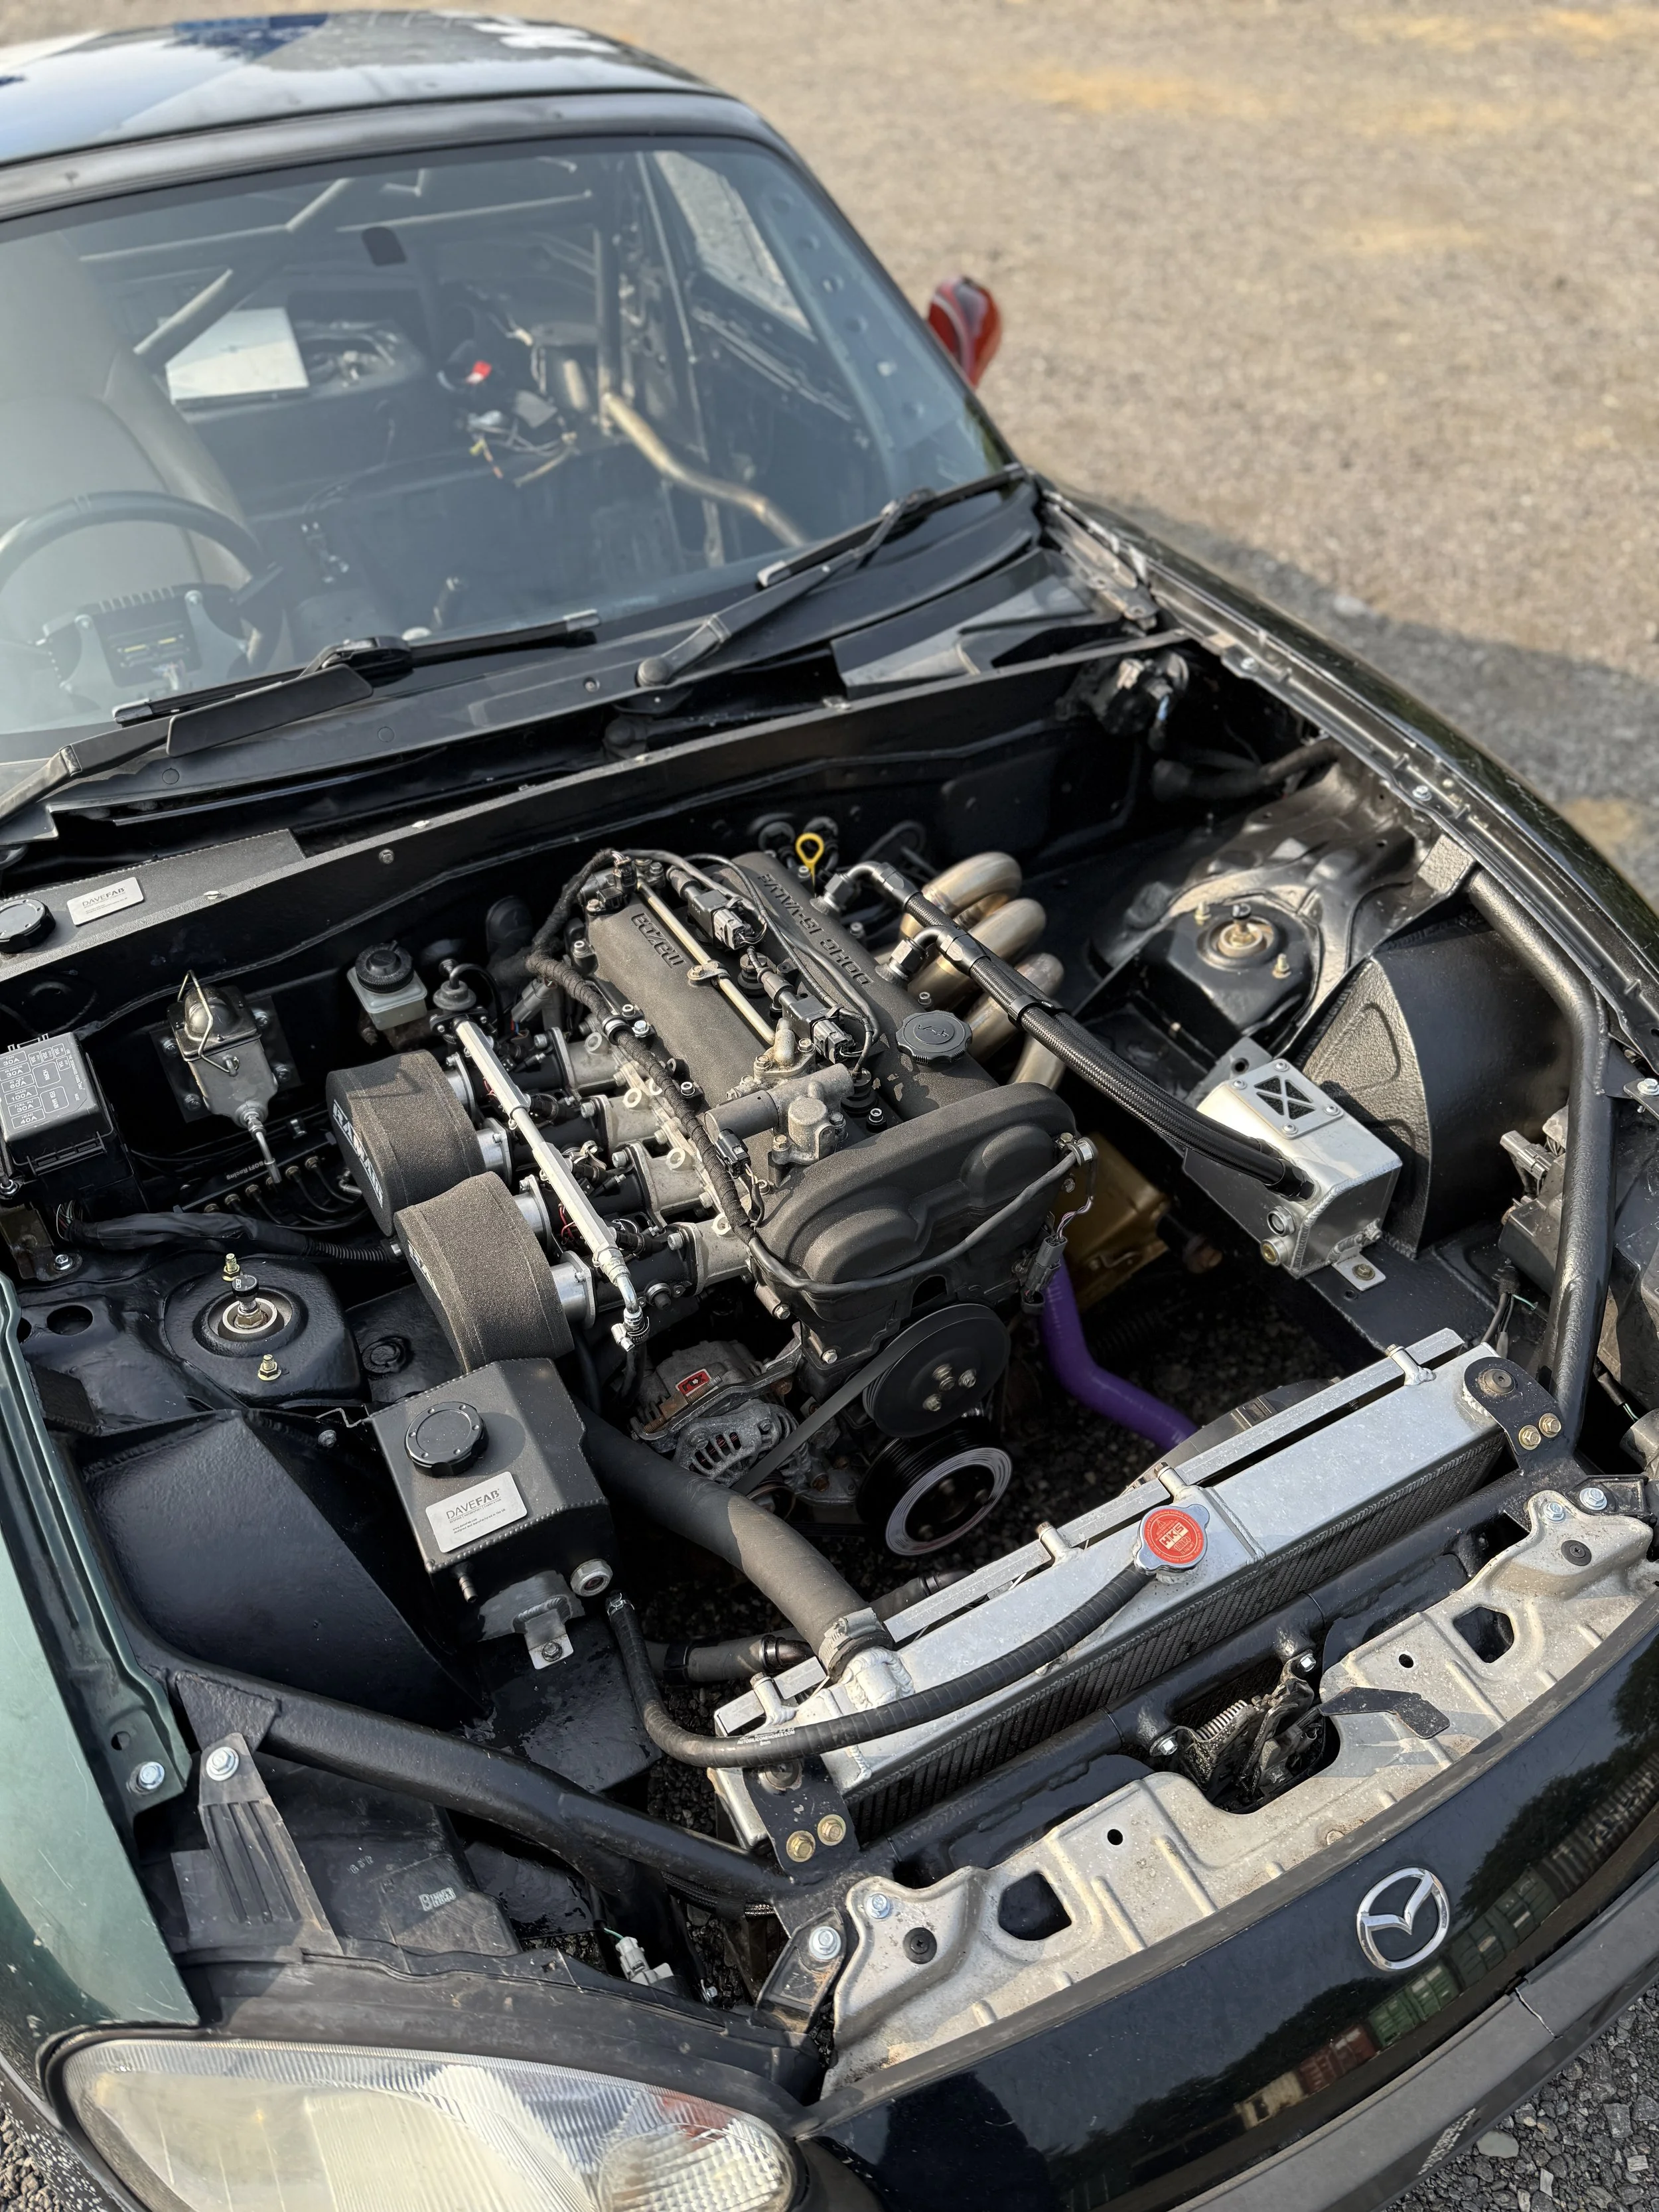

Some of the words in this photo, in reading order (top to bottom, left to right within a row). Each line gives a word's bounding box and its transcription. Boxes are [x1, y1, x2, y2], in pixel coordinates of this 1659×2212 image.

[82, 887, 125, 907] DAVEFAB
[631, 913, 687, 969] mazda
[820, 939, 874, 984] DOHC
[10, 1080, 27, 1089] 60A
[12, 1092, 33, 1101] 100A
[17, 1103, 34, 1112] 30A
[21, 1116, 37, 1124] 40A
[446, 1490, 500, 1519] DAVEFAB
[1161, 1524, 1185, 1546] HKS
